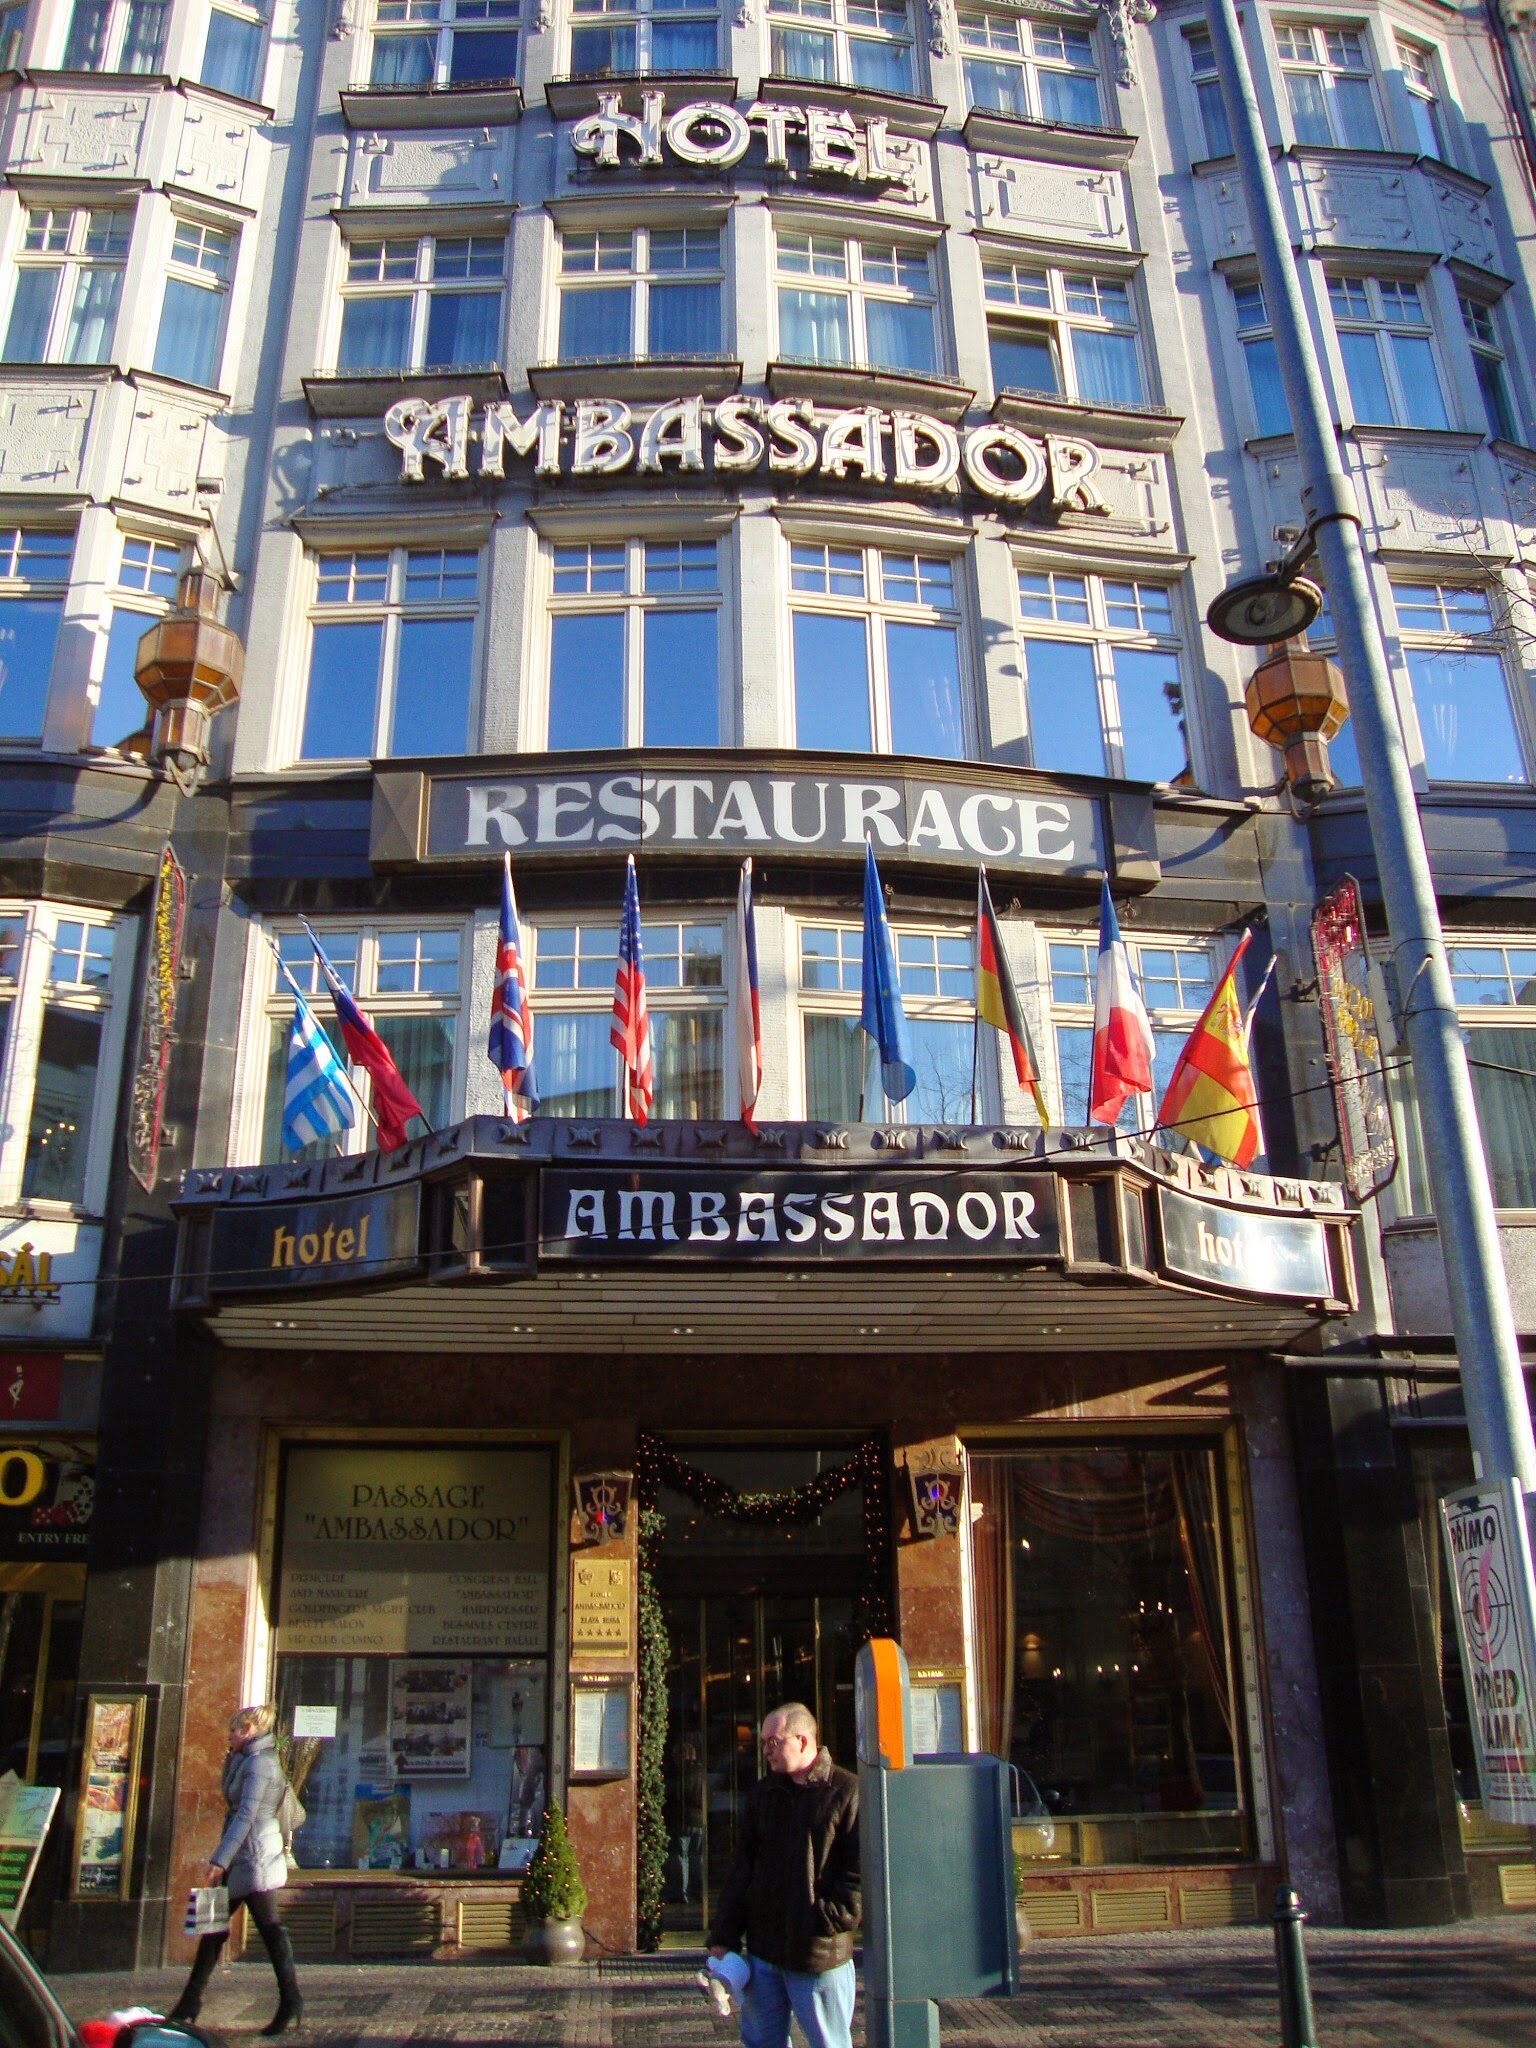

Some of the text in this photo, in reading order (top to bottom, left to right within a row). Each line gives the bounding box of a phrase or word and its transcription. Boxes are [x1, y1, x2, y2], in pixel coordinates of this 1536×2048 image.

[568, 90, 917, 186] HOTEL
[383, 393, 1115, 516] AMBASSADOR
[464, 773, 1076, 862] RESTAURACE
[272, 1214, 371, 1268] hotel
[563, 1189, 1041, 1242] AMBASSADOR
[352, 1484, 486, 1509] PASSAGE
[18, 1532, 60, 1544] ENTRY
[304, 1513, 529, 1542] "AMBASSADOR"
[310, 1634, 337, 1645] CLUB
